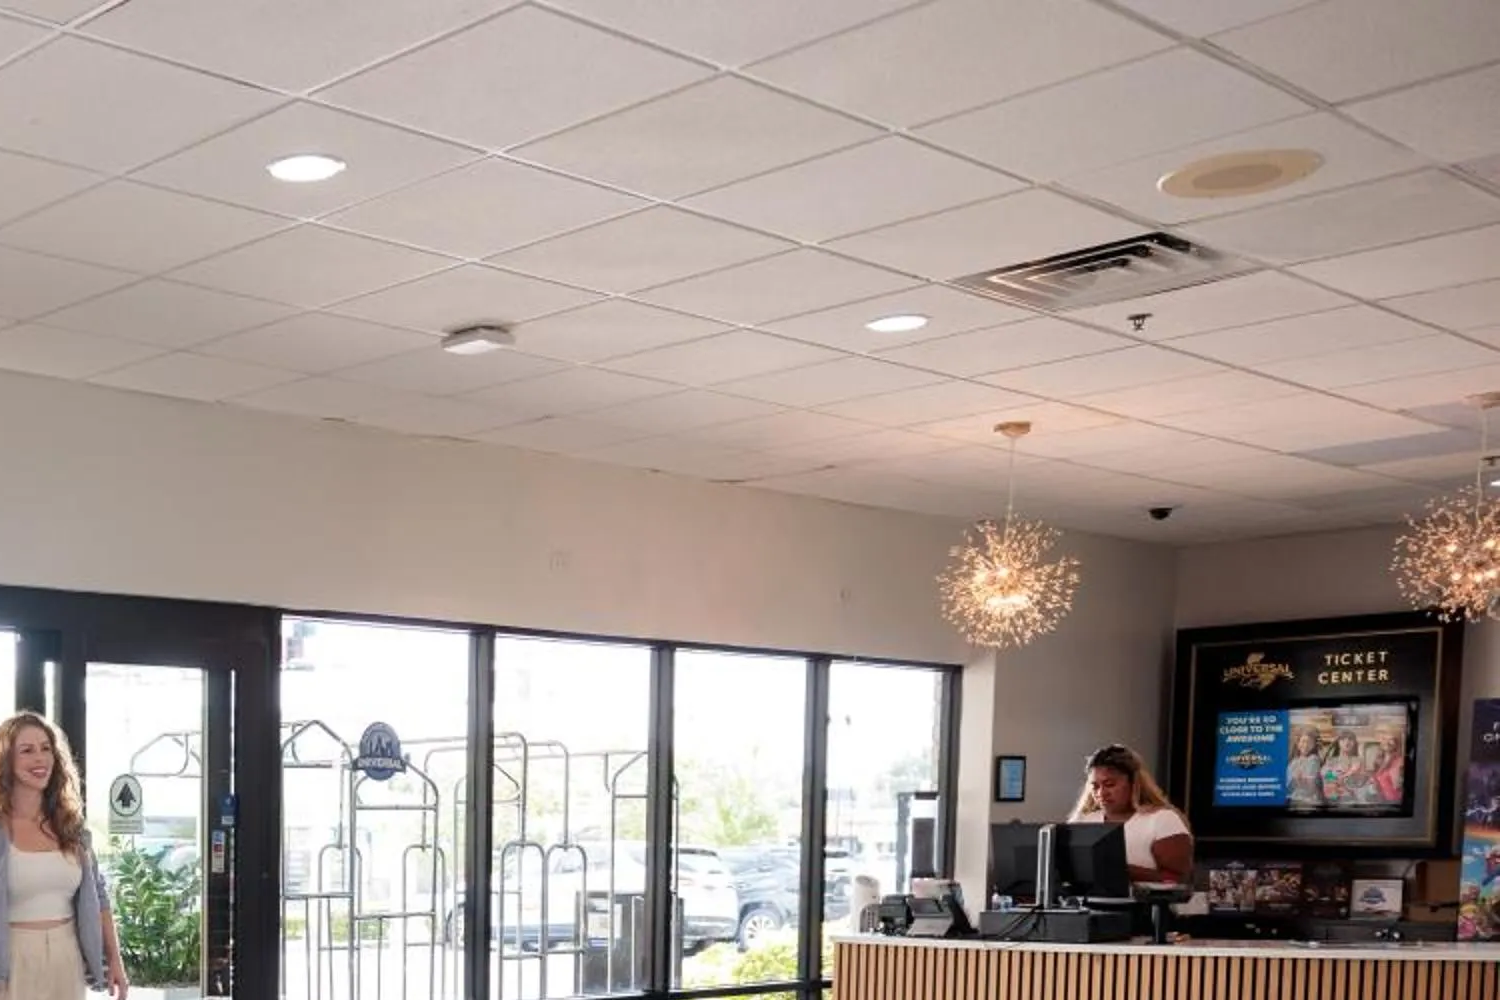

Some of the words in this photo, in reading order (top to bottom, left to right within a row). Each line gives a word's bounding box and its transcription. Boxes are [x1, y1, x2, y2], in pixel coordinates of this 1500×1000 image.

[1324, 651, 1388, 666] TICKET
[1318, 669, 1389, 685] CENTER
[1220, 725, 1248, 734] CLOSE
[1250, 725, 1263, 733] TO
